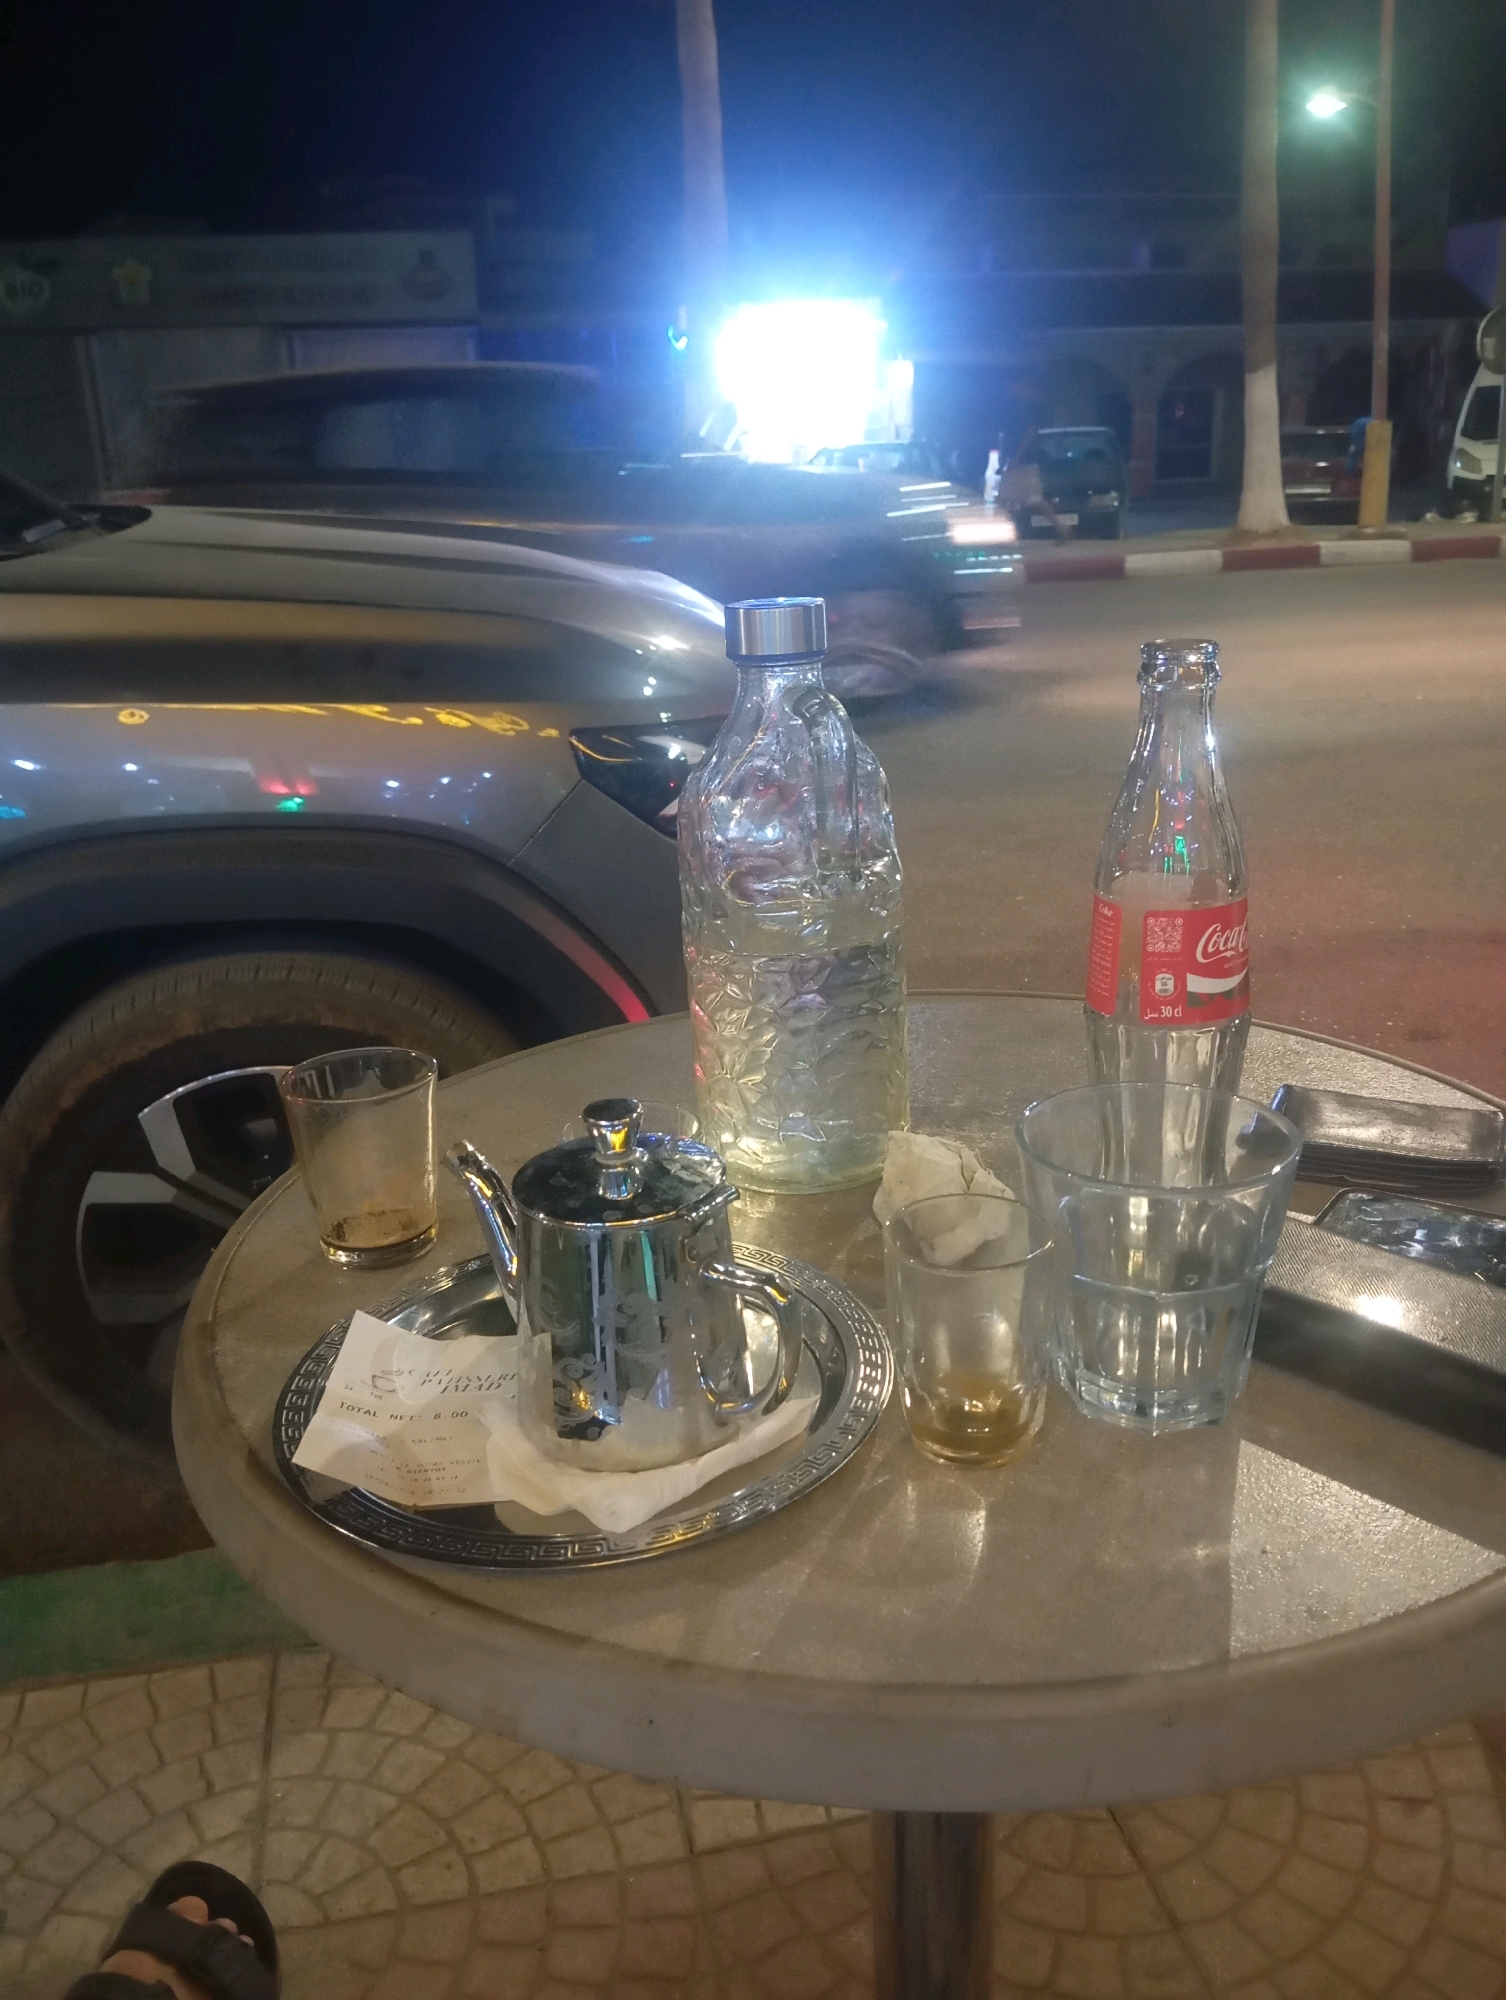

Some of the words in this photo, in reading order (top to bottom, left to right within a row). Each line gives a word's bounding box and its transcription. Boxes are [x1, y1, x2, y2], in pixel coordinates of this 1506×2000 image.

[5, 281, 44, 299] BIO
[1160, 1005, 1173, 1018] 30
[1174, 1004, 1182, 1017] cl
[339, 1401, 379, 1418] TOTAL
